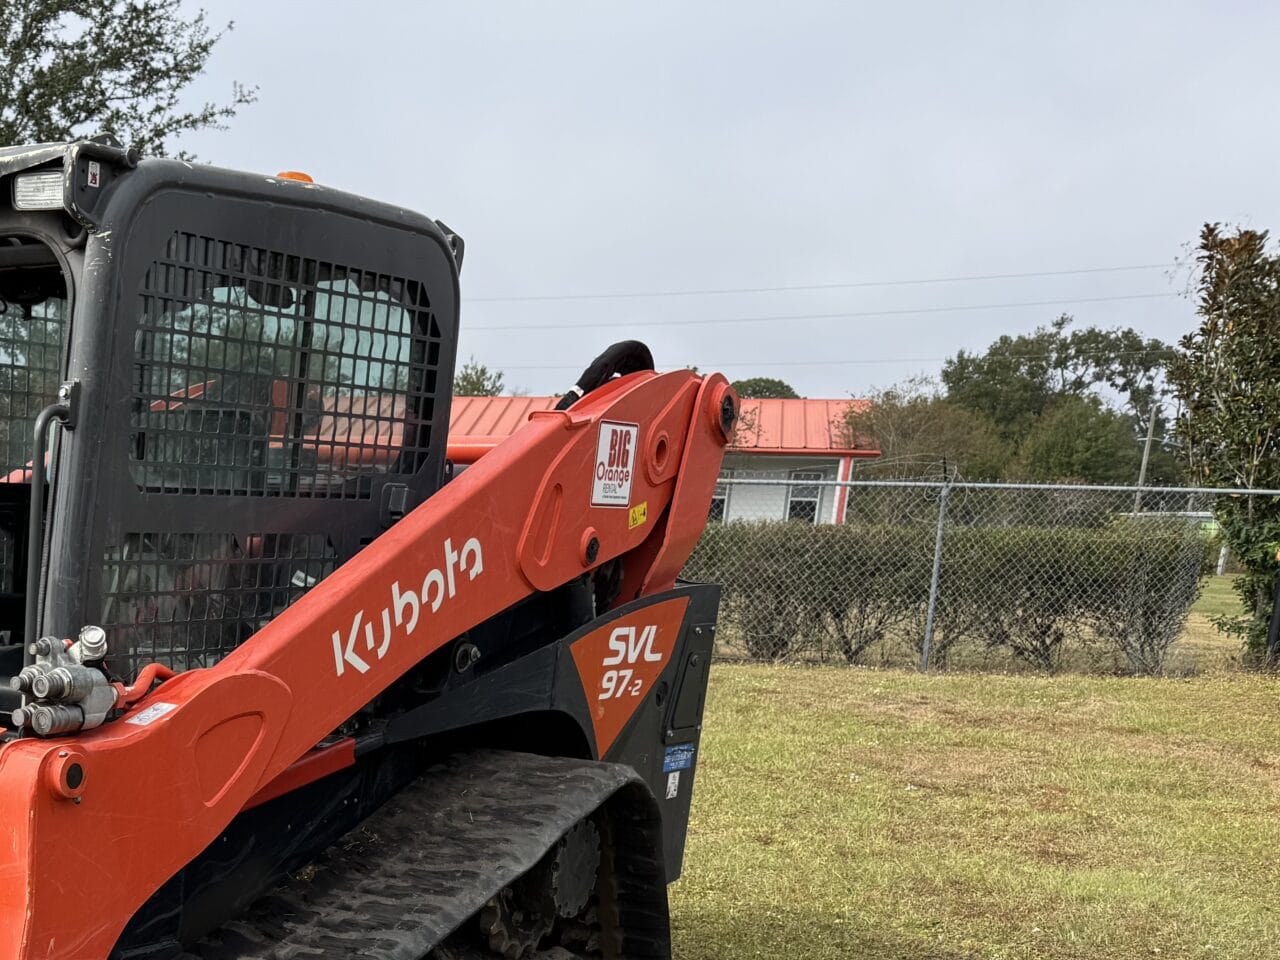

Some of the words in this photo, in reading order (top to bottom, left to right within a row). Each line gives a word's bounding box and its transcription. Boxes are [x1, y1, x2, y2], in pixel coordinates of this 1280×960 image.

[608, 428, 631, 469] BIG
[596, 461, 630, 488] Orange
[332, 536, 484, 677] Kubota
[603, 625, 663, 666] SVL
